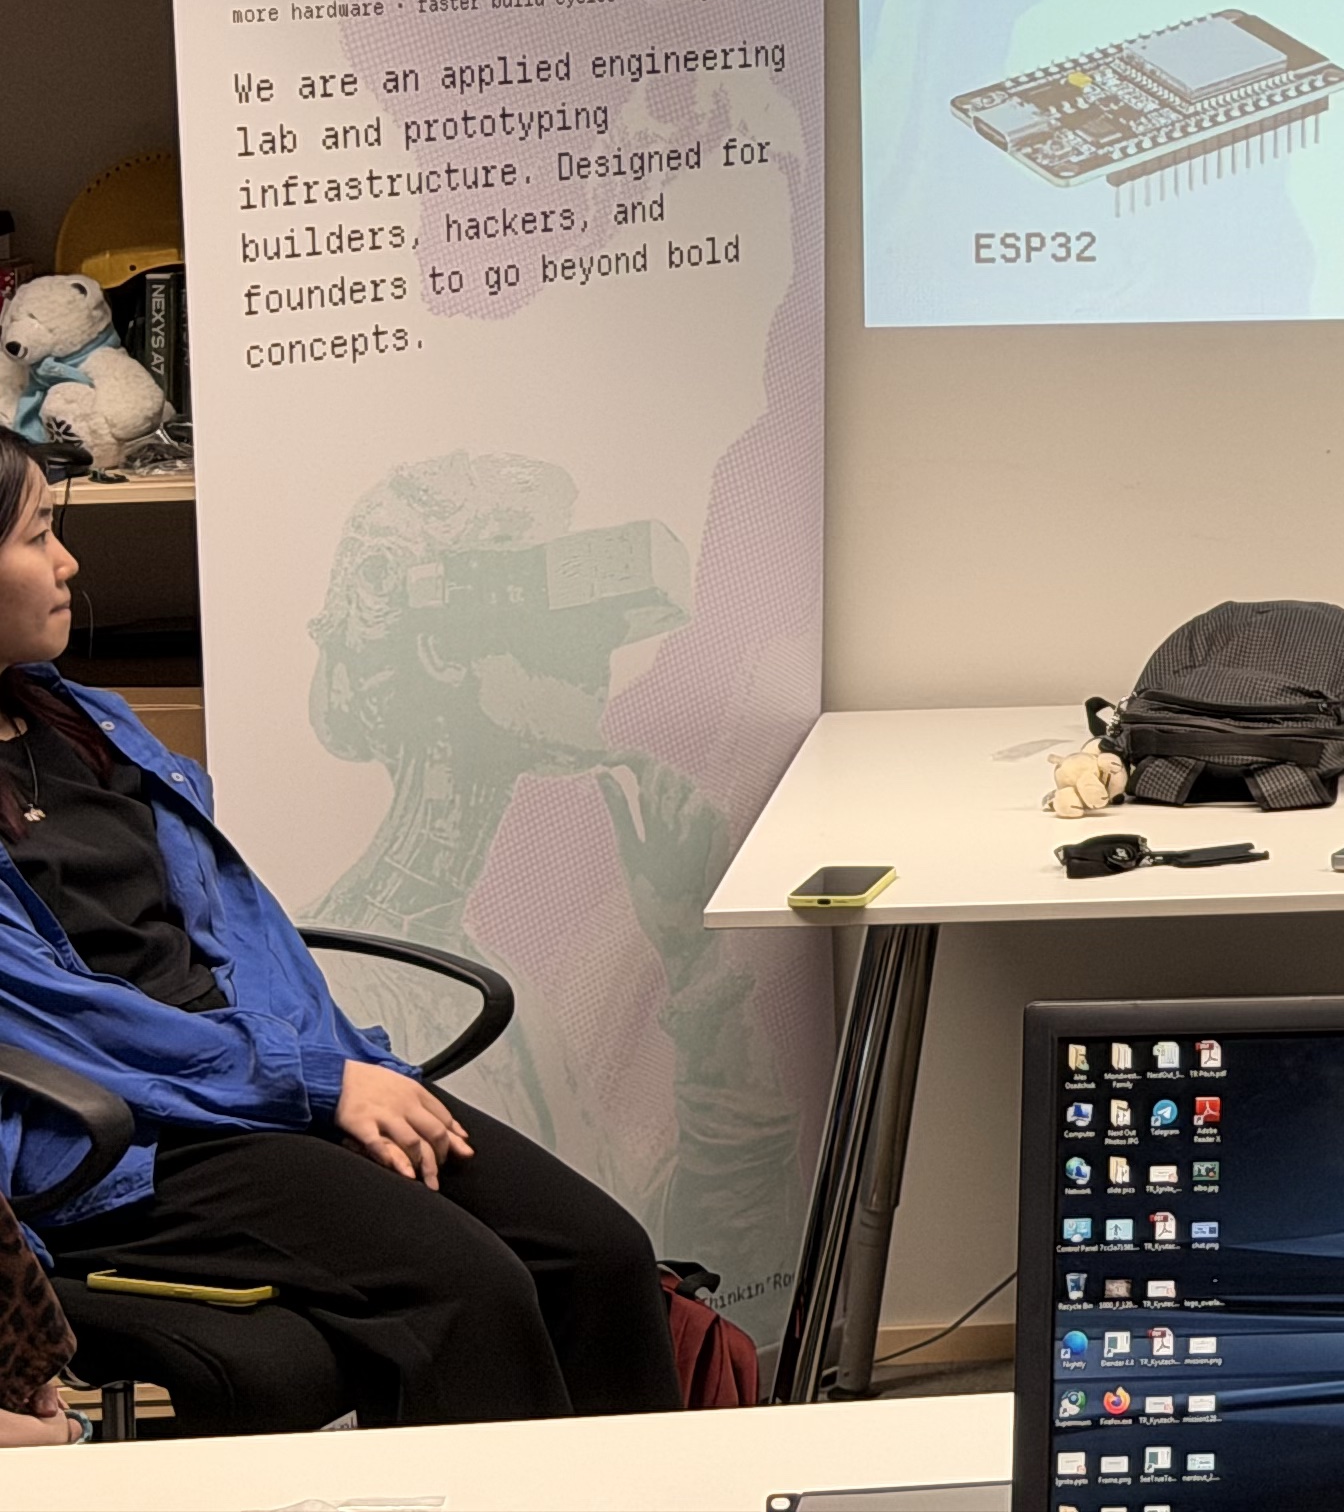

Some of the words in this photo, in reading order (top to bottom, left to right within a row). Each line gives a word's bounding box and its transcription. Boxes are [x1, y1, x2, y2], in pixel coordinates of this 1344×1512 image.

[232, 5, 277, 24] more
[234, 72, 274, 103] We
[298, 70, 358, 99] are
[383, 65, 419, 93] an
[441, 53, 571, 95] applied
[590, 40, 785, 83] engineering
[237, 125, 297, 157] lab
[322, 117, 382, 148] and
[404, 103, 609, 150] prototyping
[240, 162, 532, 210] infrastructure.
[557, 142, 701, 182] Designed
[722, 137, 770, 166] for
[242, 222, 419, 263] builders,
[446, 207, 588, 243] hackers,
[613, 193, 665, 225] and
[974, 231, 1098, 265] ESP32
[244, 274, 407, 315] founders
[430, 266, 463, 295] to
[484, 261, 521, 296] go
[542, 244, 647, 285] beyond
[668, 235, 739, 269] bold
[151, 284, 165, 348] NEXYS
[151, 351, 165, 375] A7
[246, 325, 424, 369] concepts.
